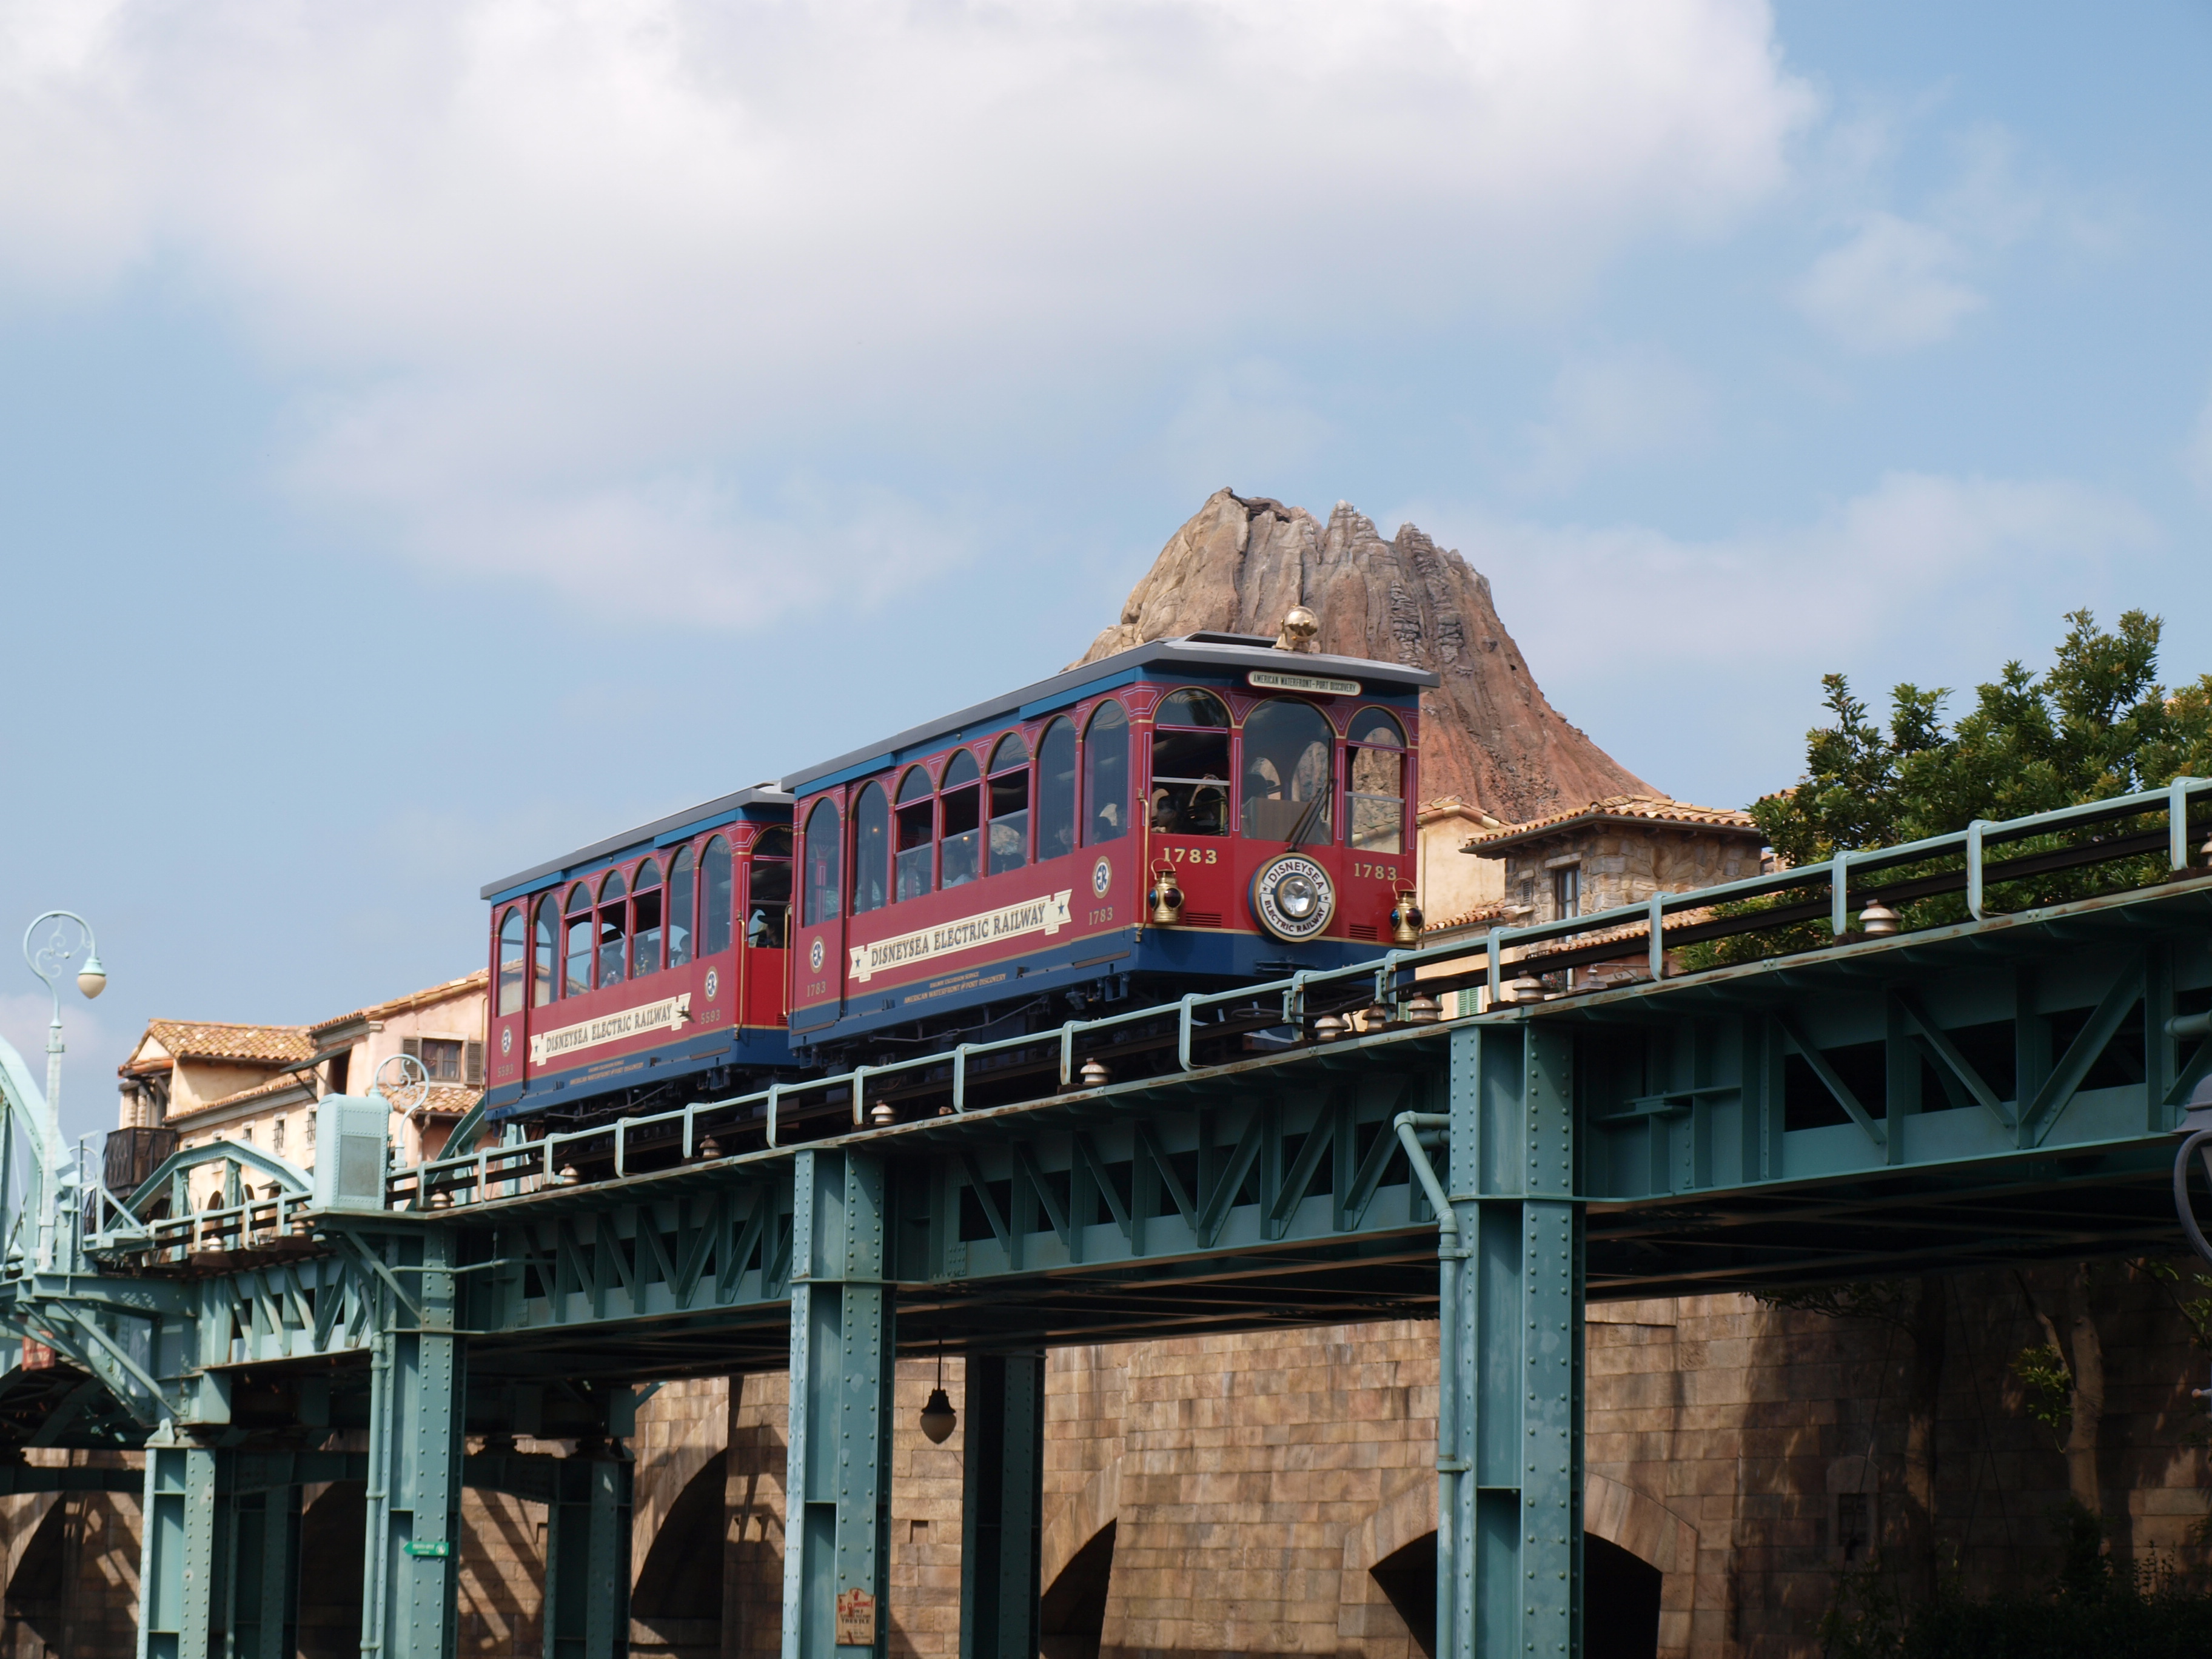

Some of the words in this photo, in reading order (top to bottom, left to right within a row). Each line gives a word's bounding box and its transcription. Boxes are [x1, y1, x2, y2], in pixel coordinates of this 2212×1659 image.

[1253, 674, 1279, 685] AMERICAN
[1330, 682, 1356, 692] DISCOVERY
[1163, 846, 1218, 865] 1783
[1268, 862, 1324, 890] DISNEYSEA
[1354, 862, 1397, 881] 1783
[1089, 905, 1113, 926] 1783
[1264, 900, 1294, 932] ELECTRIC
[1296, 907, 1325, 933] RAILWAY
[871, 934, 929, 967] DISNEYSEA
[934, 918, 989, 951] ELECTRIC
[993, 902, 1046, 936] RAILWAY
[807, 980, 826, 997] 1783
[701, 1008, 720, 1025] 5593
[546, 1027, 588, 1053] DISNEYSEA
[592, 1014, 631, 1041] ELECTRIC
[634, 1003, 672, 1029] RAILWAY
